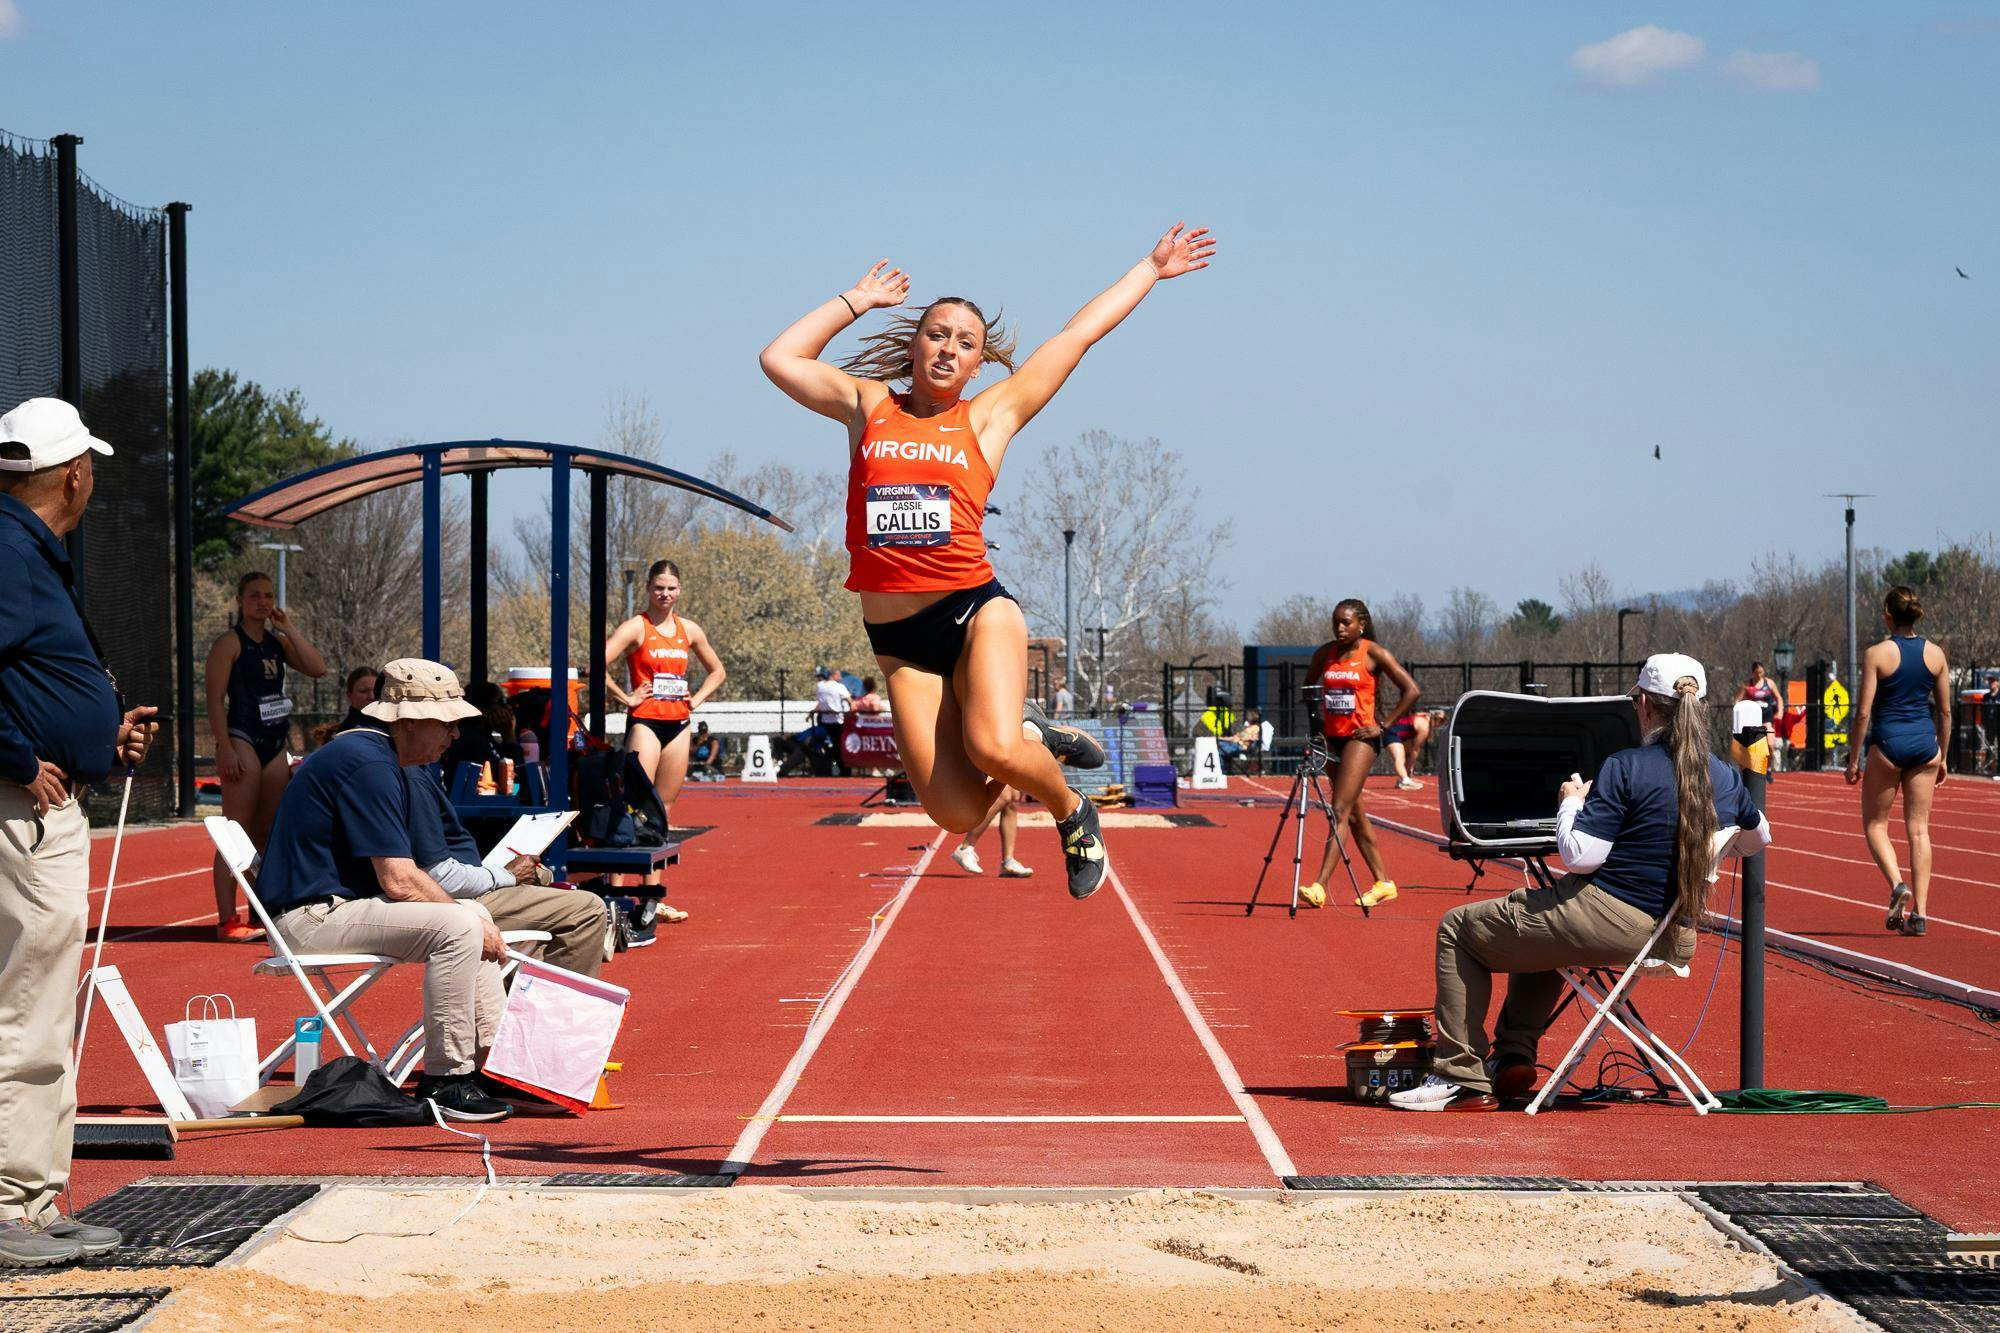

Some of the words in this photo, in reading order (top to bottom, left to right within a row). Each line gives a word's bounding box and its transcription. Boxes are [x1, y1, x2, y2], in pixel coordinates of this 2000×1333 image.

[862, 441, 969, 470] VIRGINIA
[875, 486, 918, 496] VIRGINIA
[892, 501, 923, 511] CASSIE
[876, 512, 941, 532] CALLIS
[261, 659, 277, 674] N
[753, 749, 764, 768] 6
[1204, 753, 1215, 772] 4
